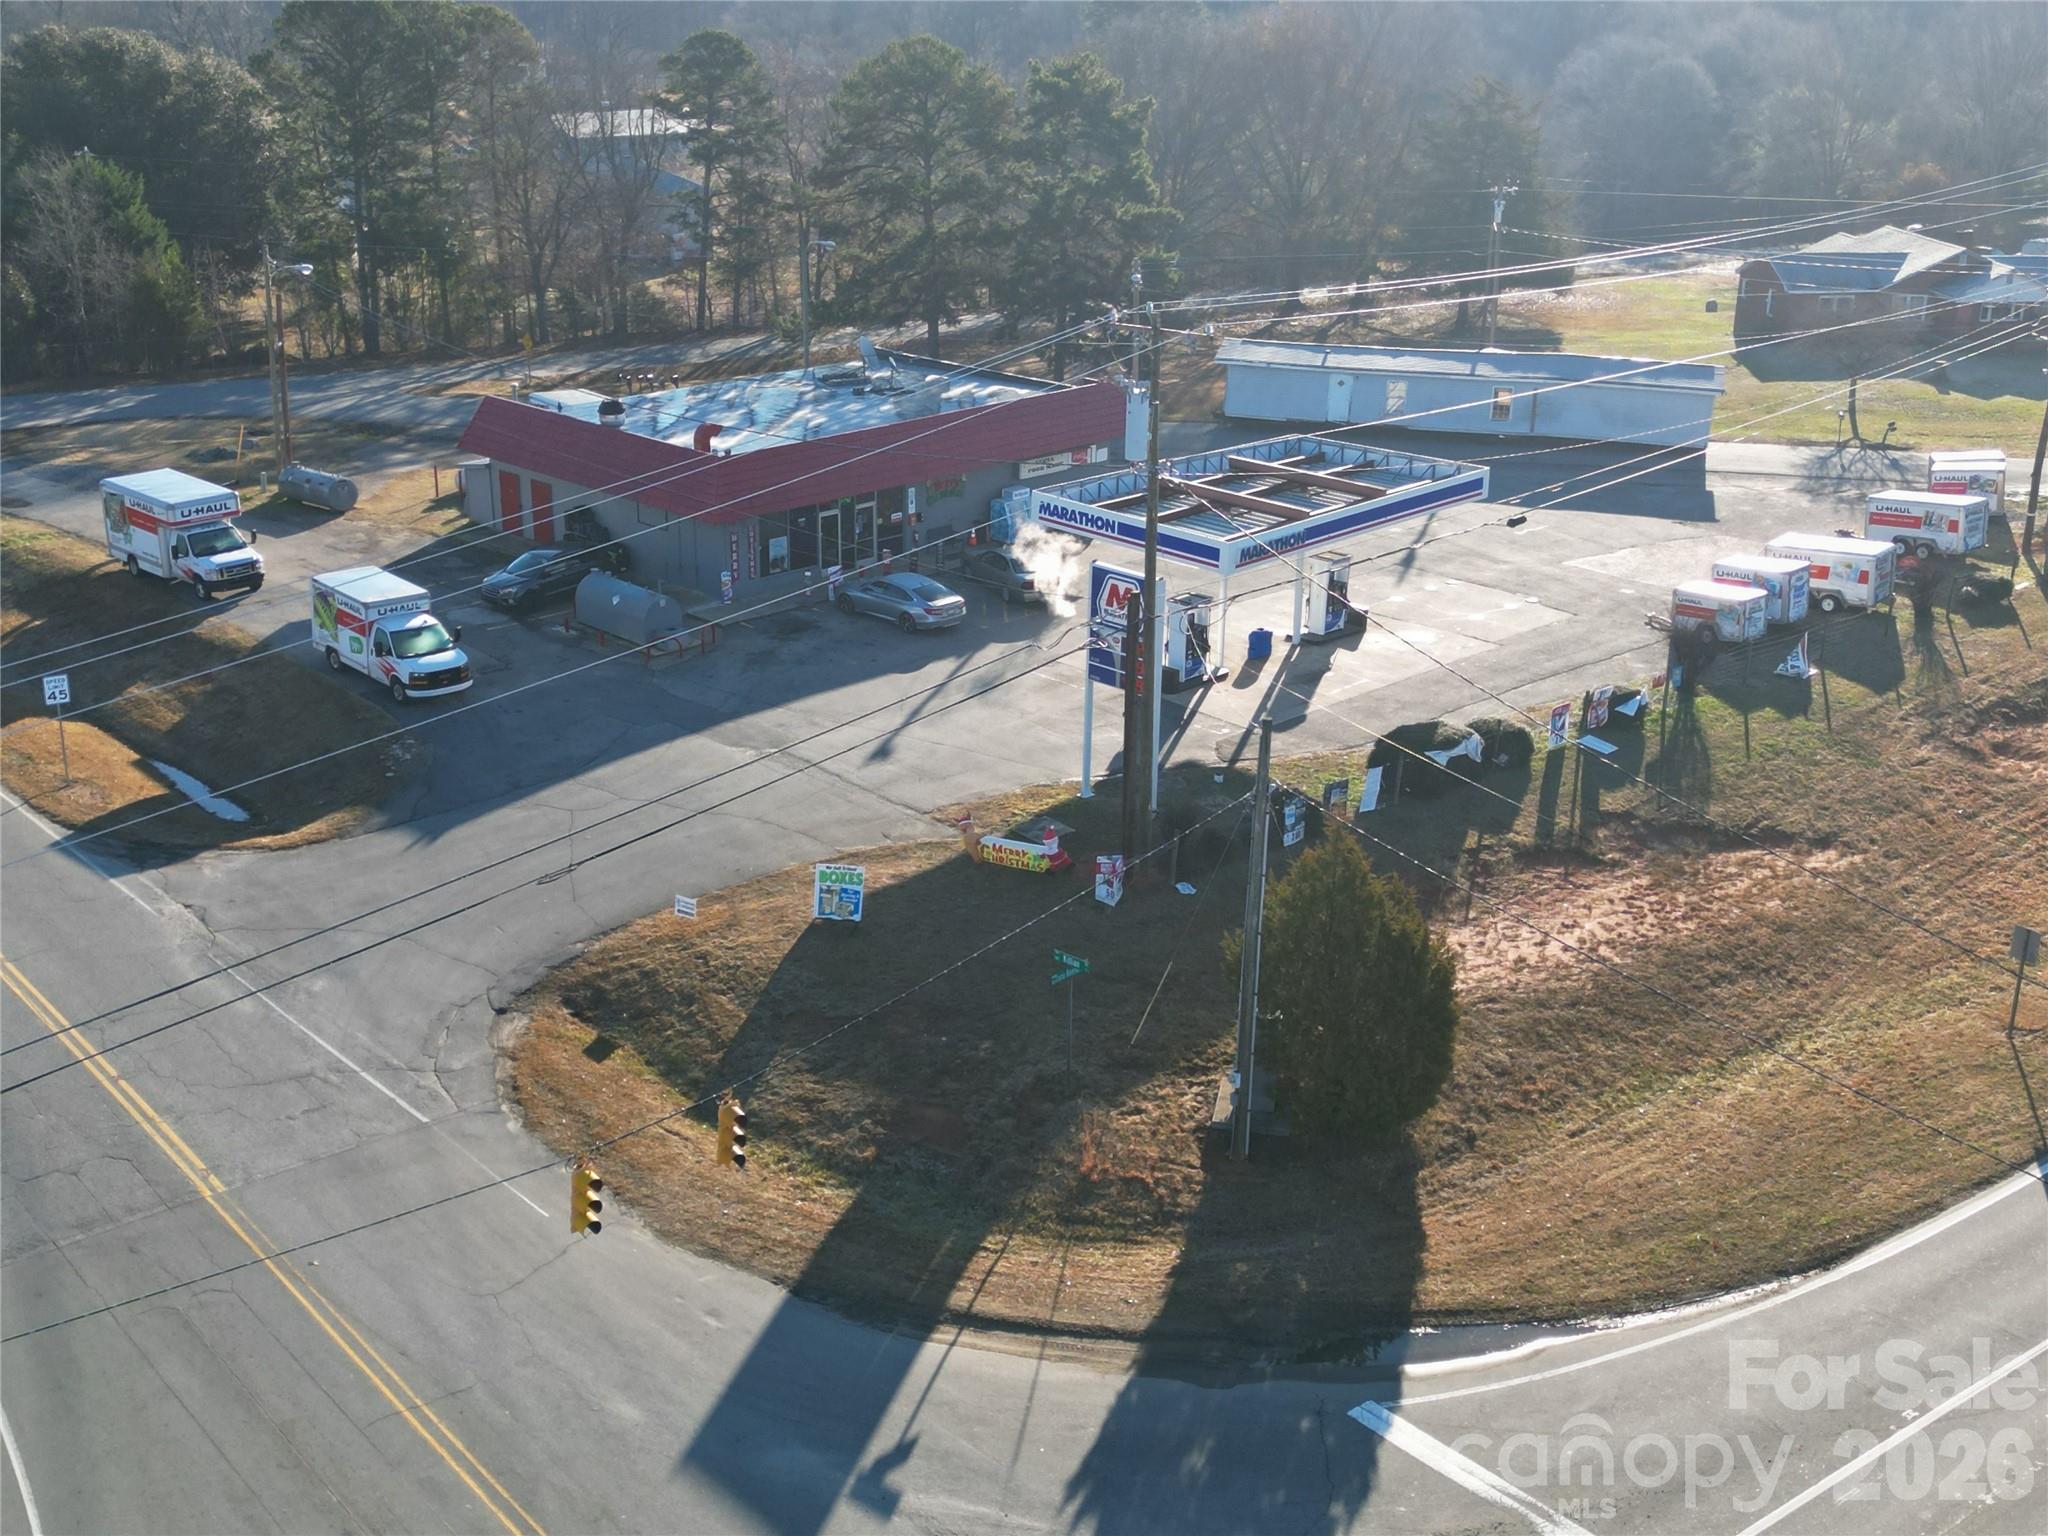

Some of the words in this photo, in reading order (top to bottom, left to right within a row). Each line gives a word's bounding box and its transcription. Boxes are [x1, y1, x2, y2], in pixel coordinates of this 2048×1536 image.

[129, 499, 156, 515] U-HAUL
[181, 502, 231, 518] U-HAUL
[1875, 504, 1913, 514] U-HAUL
[1038, 500, 1116, 535] MARATHON
[1240, 531, 1307, 563] MARATHON
[1716, 569, 1753, 580] U-HAUL
[377, 602, 422, 616] U-HAUL
[47, 689, 68, 701] 45
[819, 870, 864, 886] BOXES
